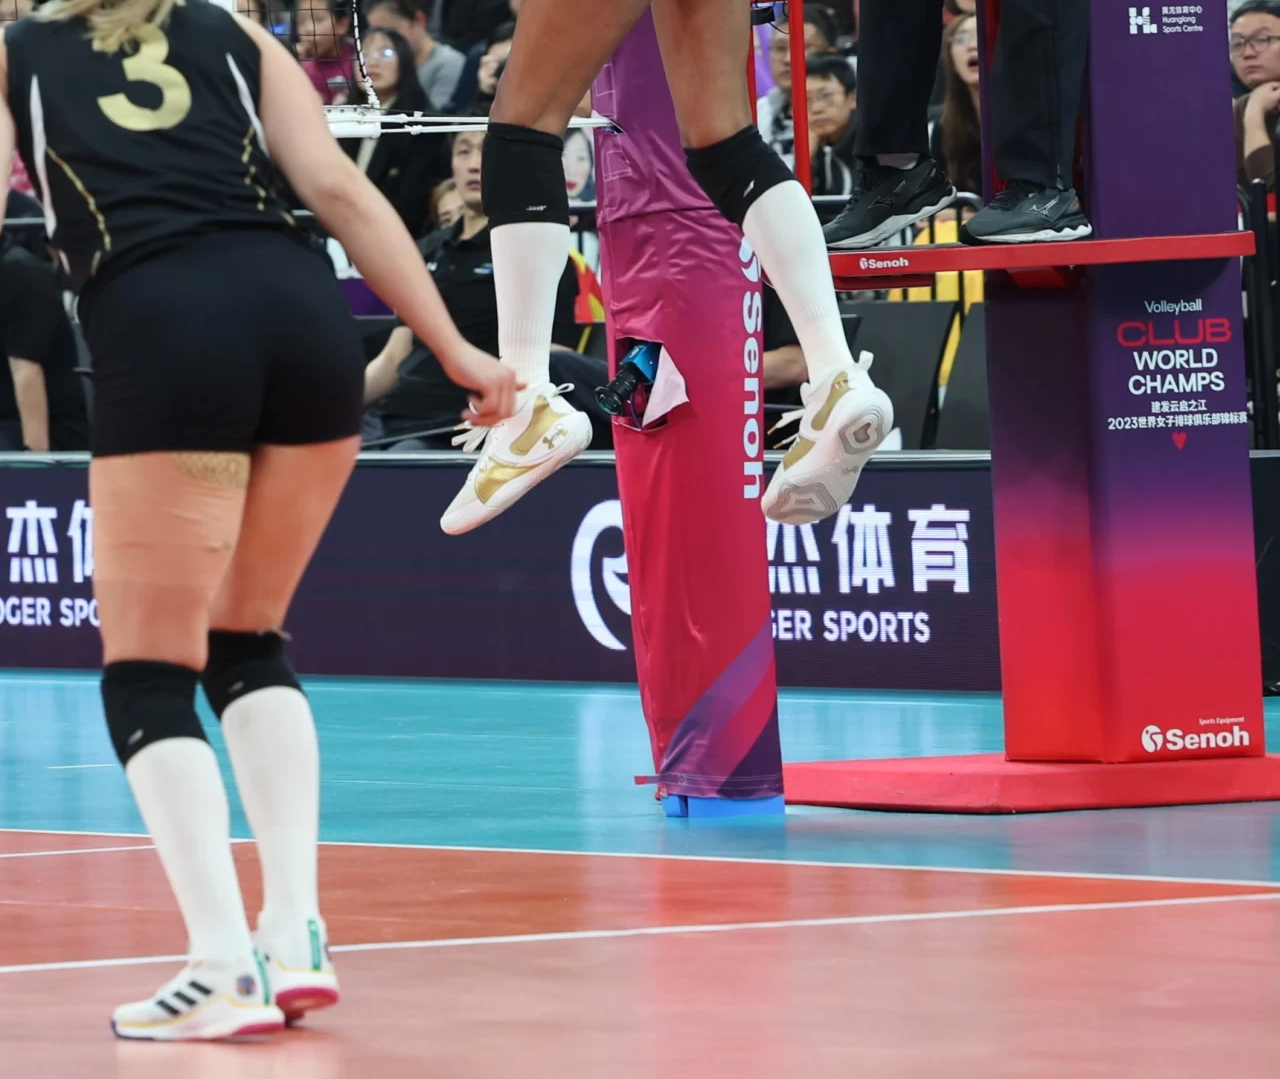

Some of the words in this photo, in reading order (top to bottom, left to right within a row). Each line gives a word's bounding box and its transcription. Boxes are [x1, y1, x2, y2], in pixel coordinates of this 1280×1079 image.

[1162, 16, 1196, 24] Huanglong
[1162, 25, 1182, 33] Sports
[91, 23, 192, 132] 3
[868, 257, 910, 269] Senoh
[1145, 298, 1203, 316] Volleyball
[1117, 318, 1233, 347] CLUB
[1133, 348, 1218, 371] WORLD
[1128, 371, 1225, 395] CHAMPS
[742, 290, 763, 500] Senoh
[1151, 399, 1208, 413] 建发云启之江
[823, 610, 931, 644] SPORTS
[1216, 716, 1245, 726] Equipment
[1166, 726, 1250, 751] Senoh
